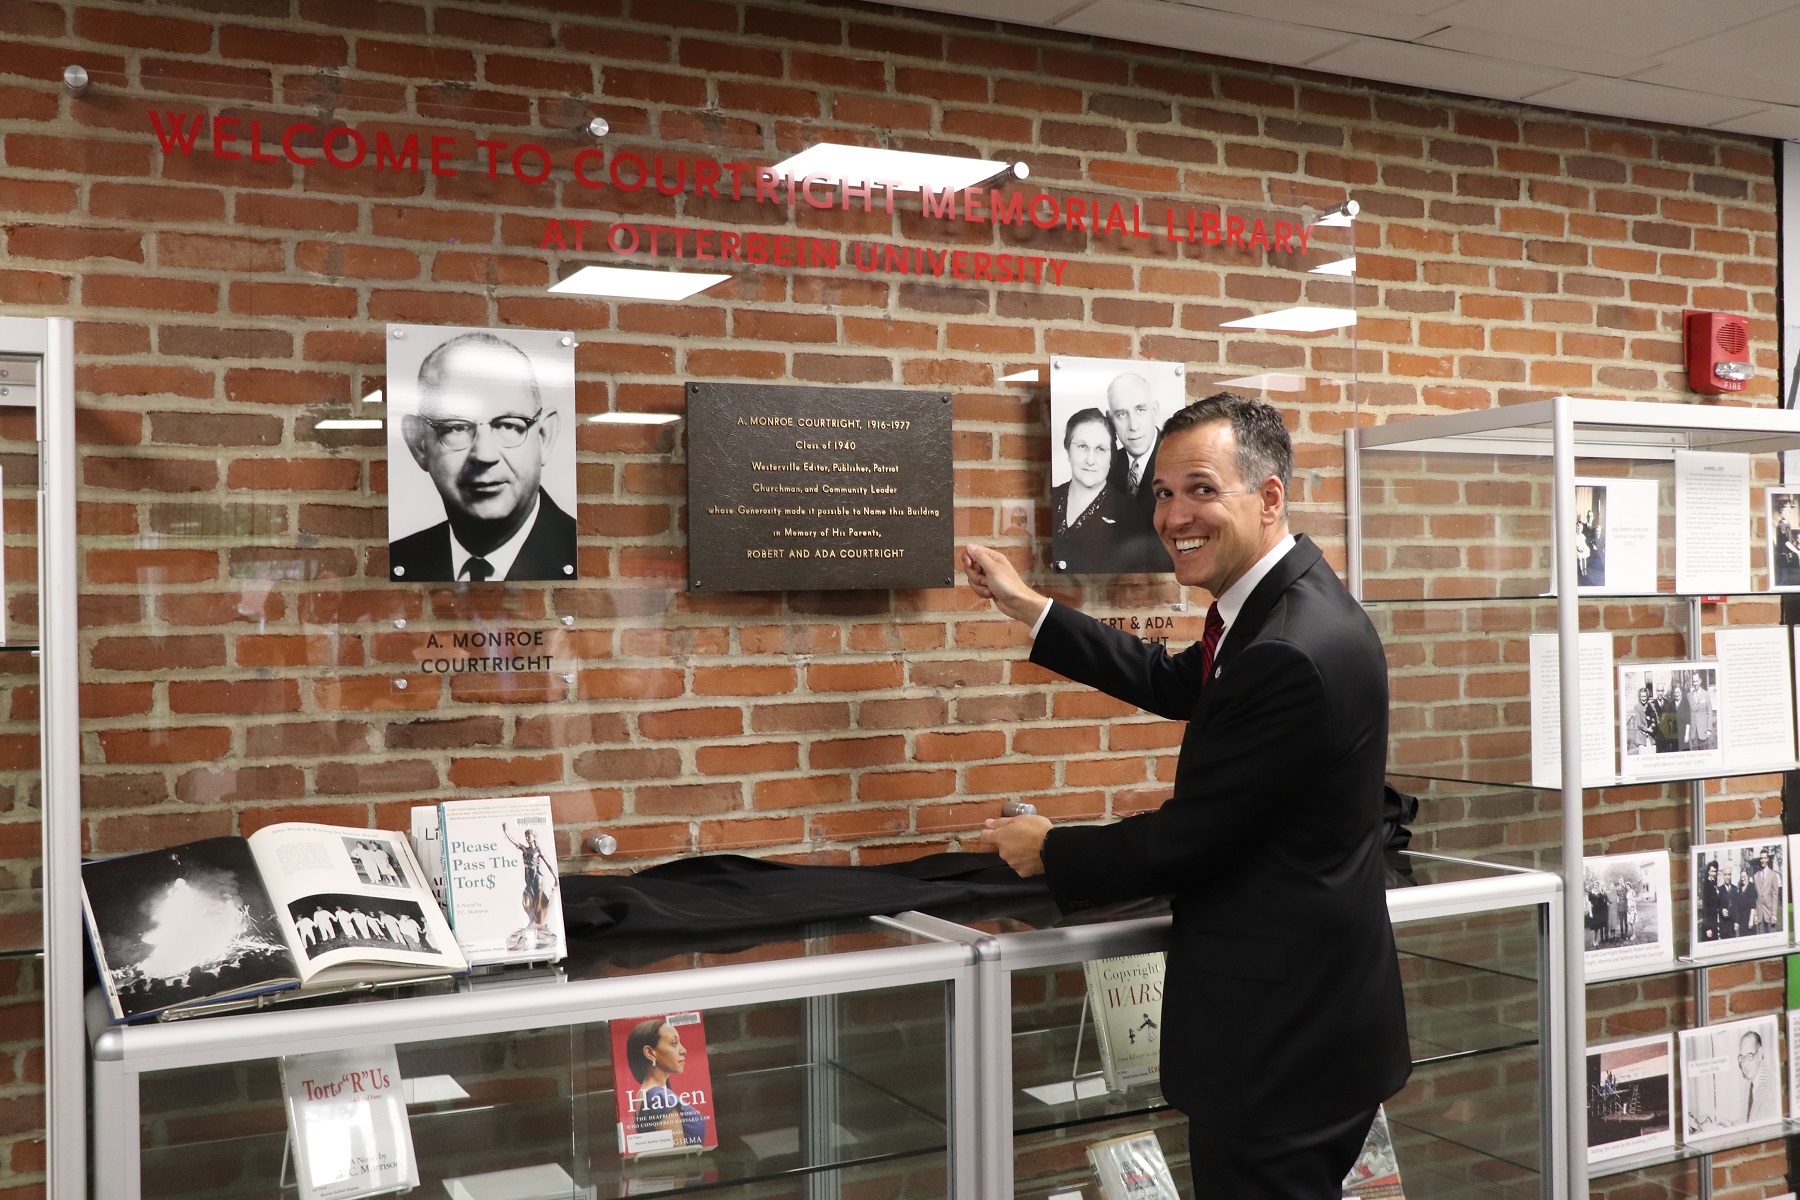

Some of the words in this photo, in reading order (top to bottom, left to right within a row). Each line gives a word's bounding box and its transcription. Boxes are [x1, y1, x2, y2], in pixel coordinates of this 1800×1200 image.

[148, 110, 457, 177] WELCOME
[477, 140, 552, 183] TO
[573, 149, 902, 215] COURTRIGHT
[921, 183, 1151, 239] MEMORIAL
[1167, 208, 1314, 255] LIBRARY
[540, 218, 592, 251] AT
[607, 222, 841, 270] OTTERBEIN
[855, 242, 1068, 287] UNIVERSITY
[1724, 382, 1741, 390] FIRE
[737, 417, 746, 426] A.
[750, 417, 793, 428] MONROE
[798, 418, 862, 430] COURTRIGHT,
[866, 420, 910, 431] 1916-1977
[795, 441, 819, 450] Class
[822, 441, 831, 450] of
[834, 441, 856, 451] 1940
[752, 462, 800, 472] Westerville
[803, 463, 830, 474] Editor,
[832, 464, 872, 474] Publisher,
[873, 464, 899, 473] Patriot
[752, 483, 802, 494] Churchman,
[804, 484, 819, 494] and
[822, 485, 868, 496] Community
[870, 485, 898, 494] Leader
[708, 506, 734, 515] whose
[738, 506, 783, 518] Generosity
[784, 506, 806, 516] made
[808, 507, 814, 515] it
[817, 507, 850, 518] possible
[852, 508, 861, 516] to
[863, 507, 886, 516] Name
[889, 507, 904, 516] this
[907, 507, 940, 518] Building
[784, 528, 817, 539] Memory
[820, 528, 829, 537] of
[832, 528, 846, 538] His
[848, 528, 882, 538] Parents,
[747, 550, 784, 559] ROBERT
[788, 550, 810, 559] AND
[814, 550, 836, 558] ADA
[840, 549, 904, 559] COURTRIGHT
[1130, 616, 1140, 630] &
[1145, 616, 1174, 629] ADA
[427, 634, 443, 648] A.
[453, 632, 544, 648] MONROE
[421, 656, 553, 674] COURTRIGHT
[451, 841, 498, 854] Please
[452, 858, 486, 872] Pass
[489, 856, 518, 869] The
[454, 874, 496, 890] Tort$
[1104, 964, 1160, 982] Copyright
[1108, 981, 1162, 1009] WARS
[302, 1080, 343, 1101] Torts
[369, 1068, 391, 1090] Us
[626, 1086, 706, 1113] Haben
[640, 1119, 674, 1128] CONQUERED
[674, 1116, 700, 1124] HARVARD
[648, 1112, 679, 1121] DEAFBLIND
[673, 1136, 702, 1146] GIRMA
[378, 1152, 388, 1162] by
